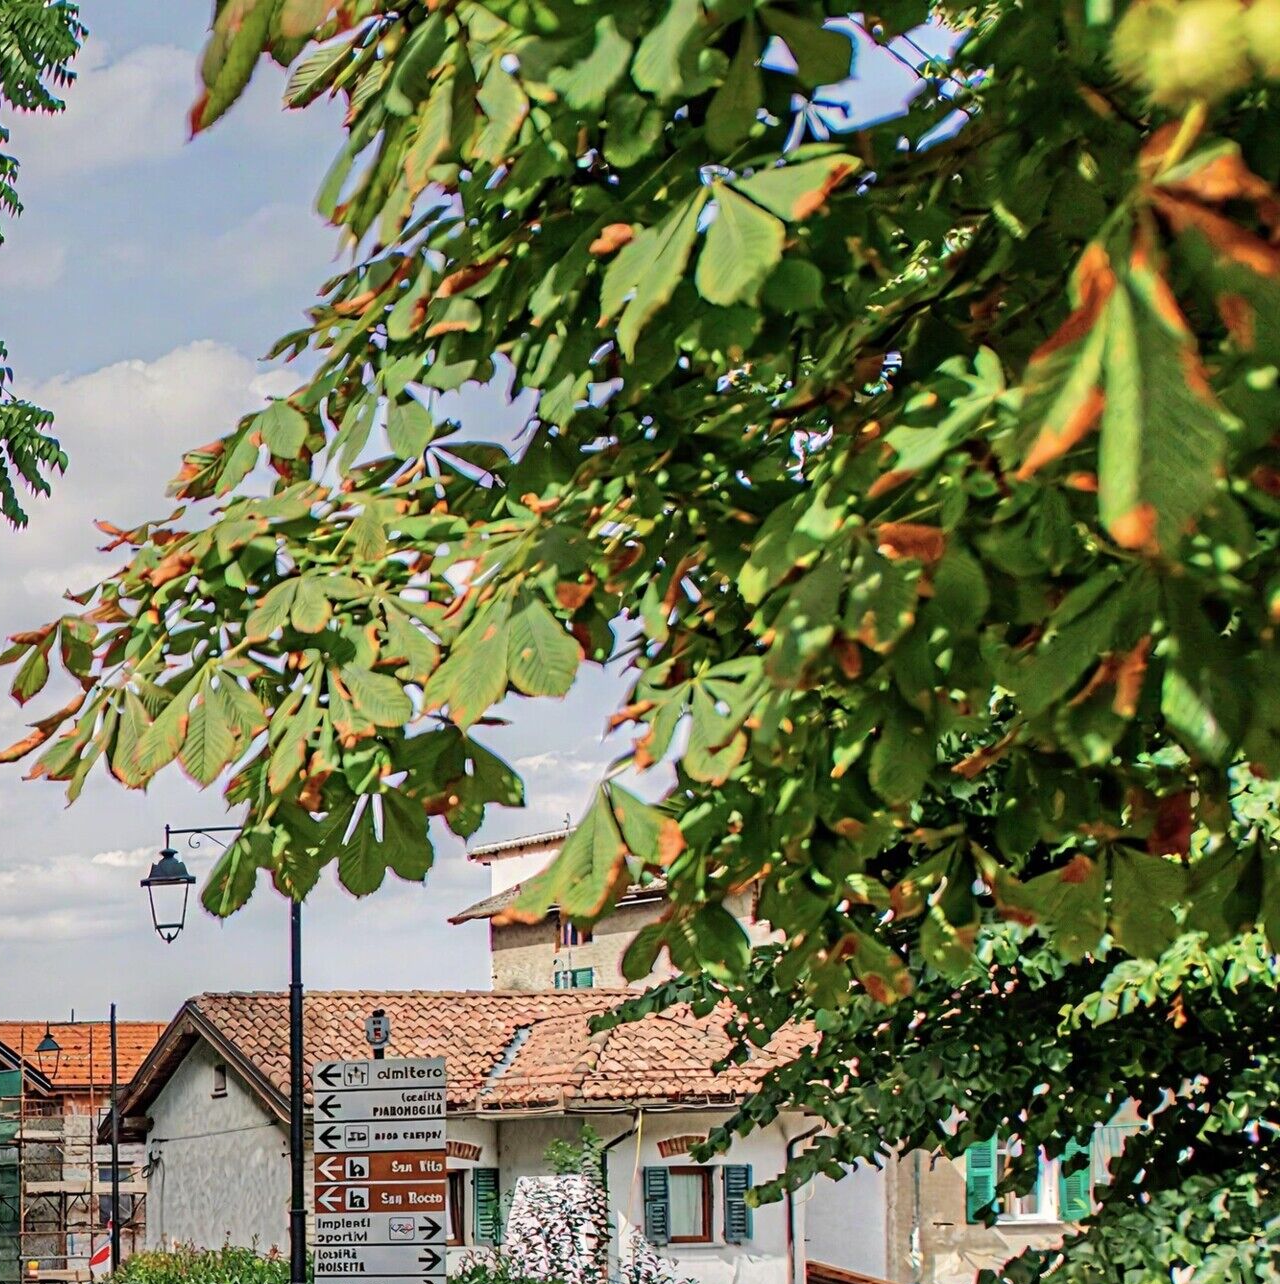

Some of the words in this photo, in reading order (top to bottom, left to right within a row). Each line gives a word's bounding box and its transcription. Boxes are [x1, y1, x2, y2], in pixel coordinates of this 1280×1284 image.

[391, 1160, 413, 1173] San
[380, 1192, 402, 1205] San
[407, 1191, 443, 1205] Rocco
